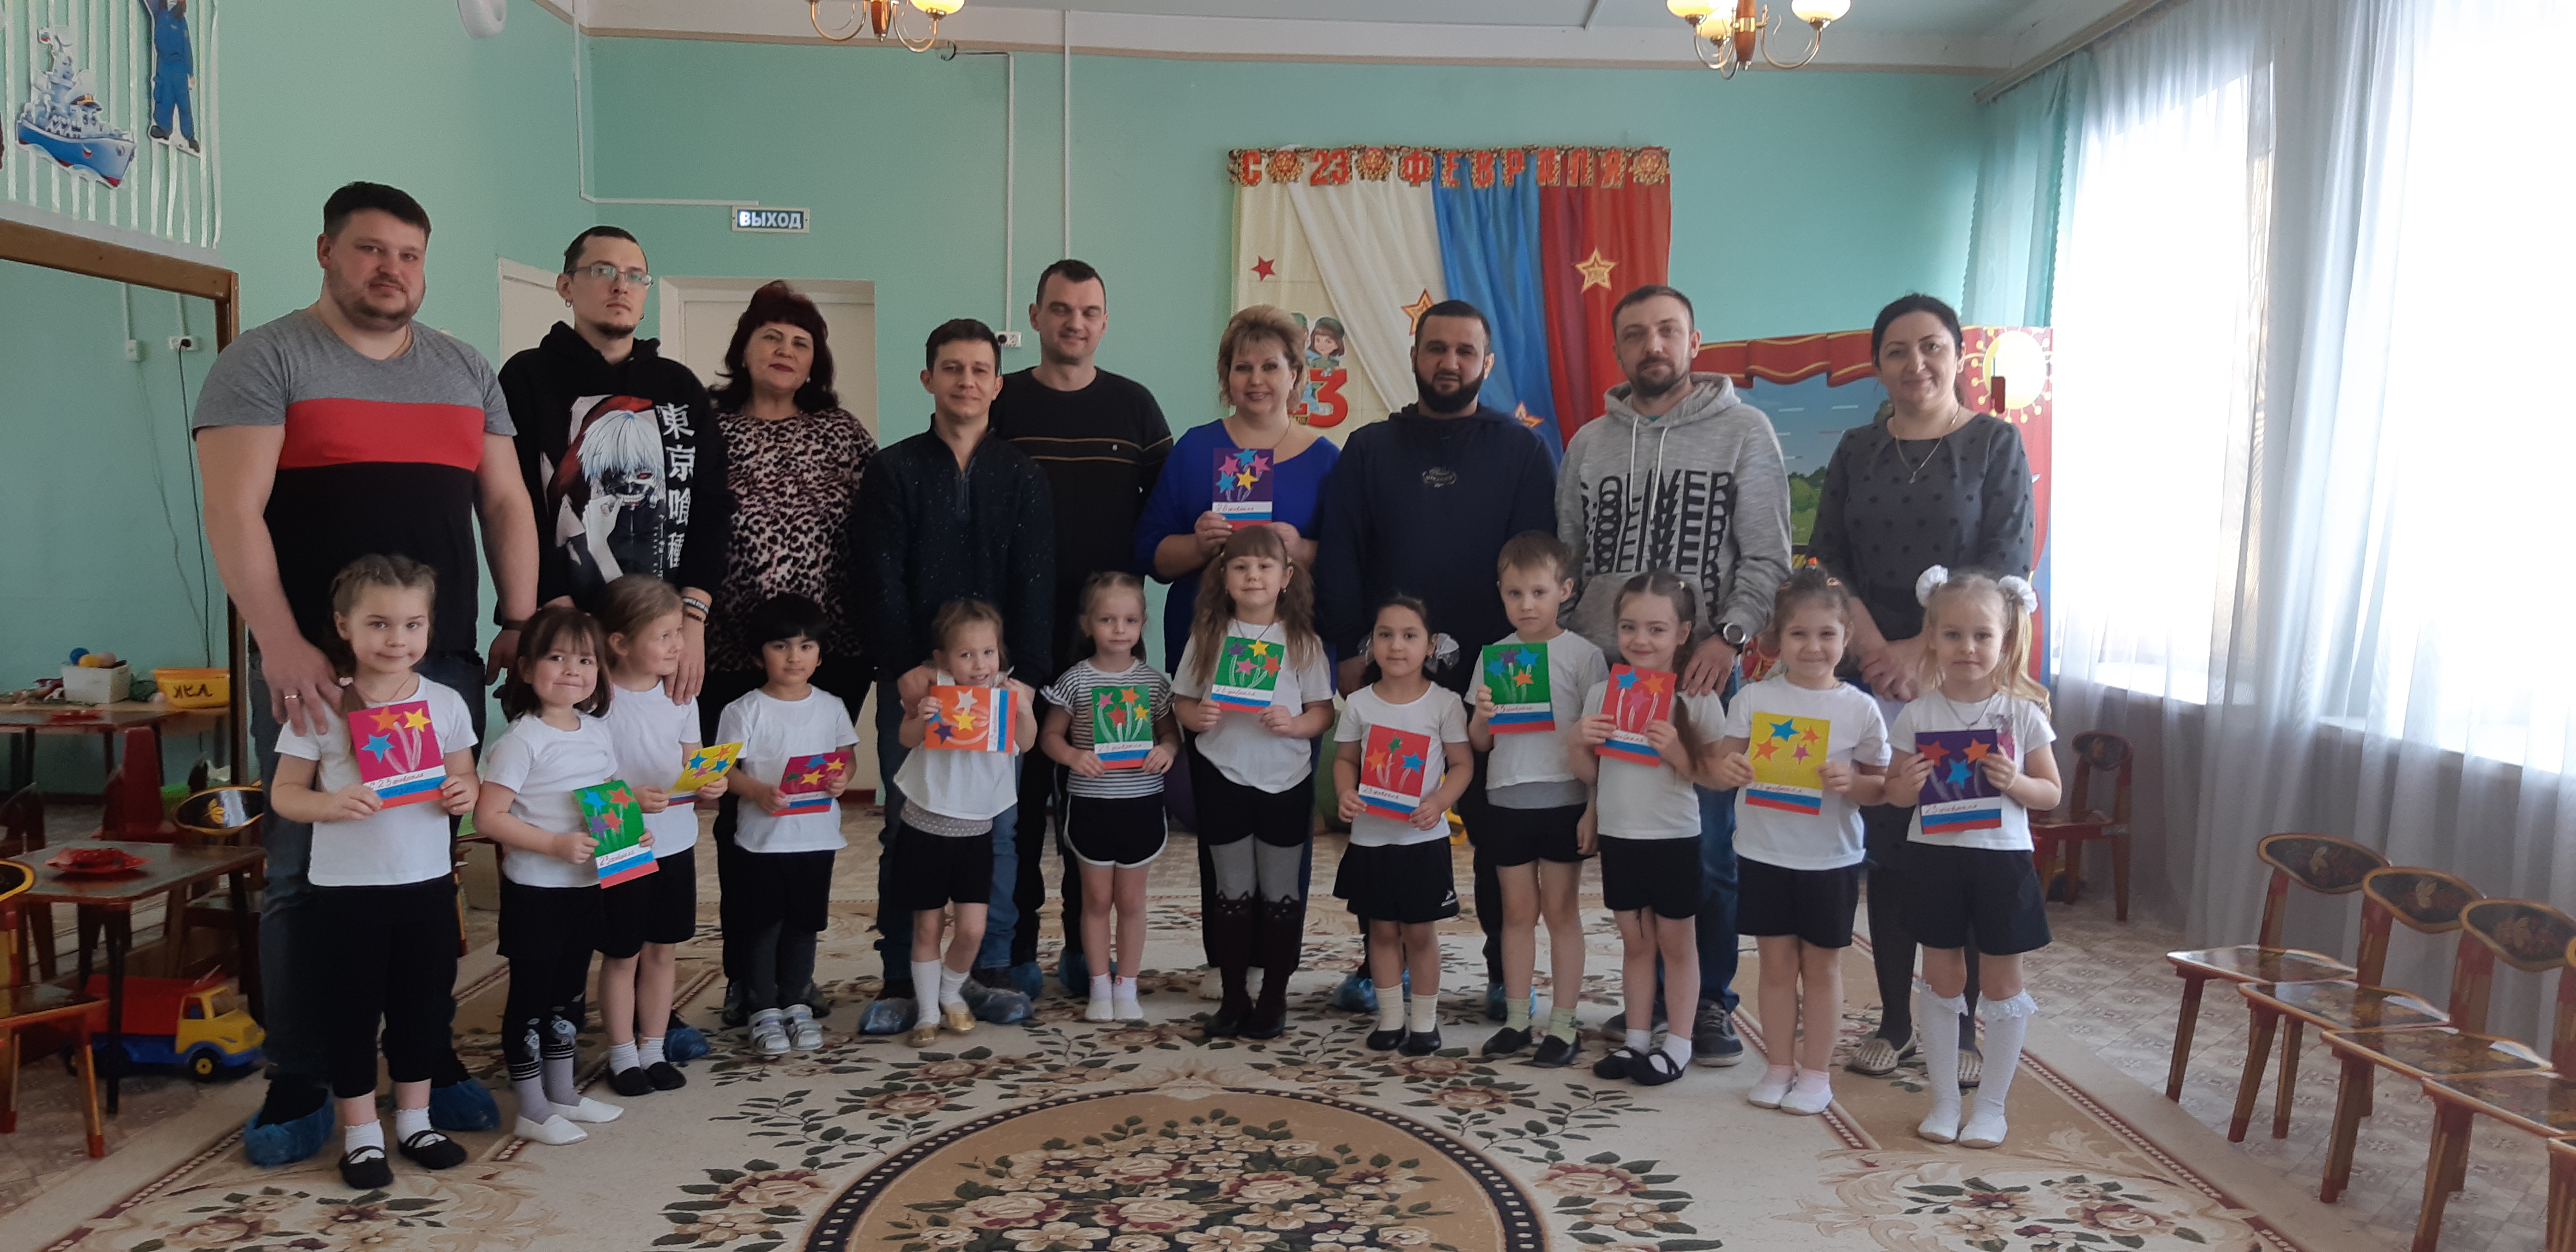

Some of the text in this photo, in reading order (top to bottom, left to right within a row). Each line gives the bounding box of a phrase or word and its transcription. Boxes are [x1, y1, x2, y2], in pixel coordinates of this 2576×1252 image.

[1242, 149, 1624, 187] С 23 ФЕВРАЛЯ
[740, 211, 802, 229] ВЫХОД
[378, 777, 392, 788] 23
[392, 772, 424, 784] февраля
[1373, 790, 1399, 799] февраля
